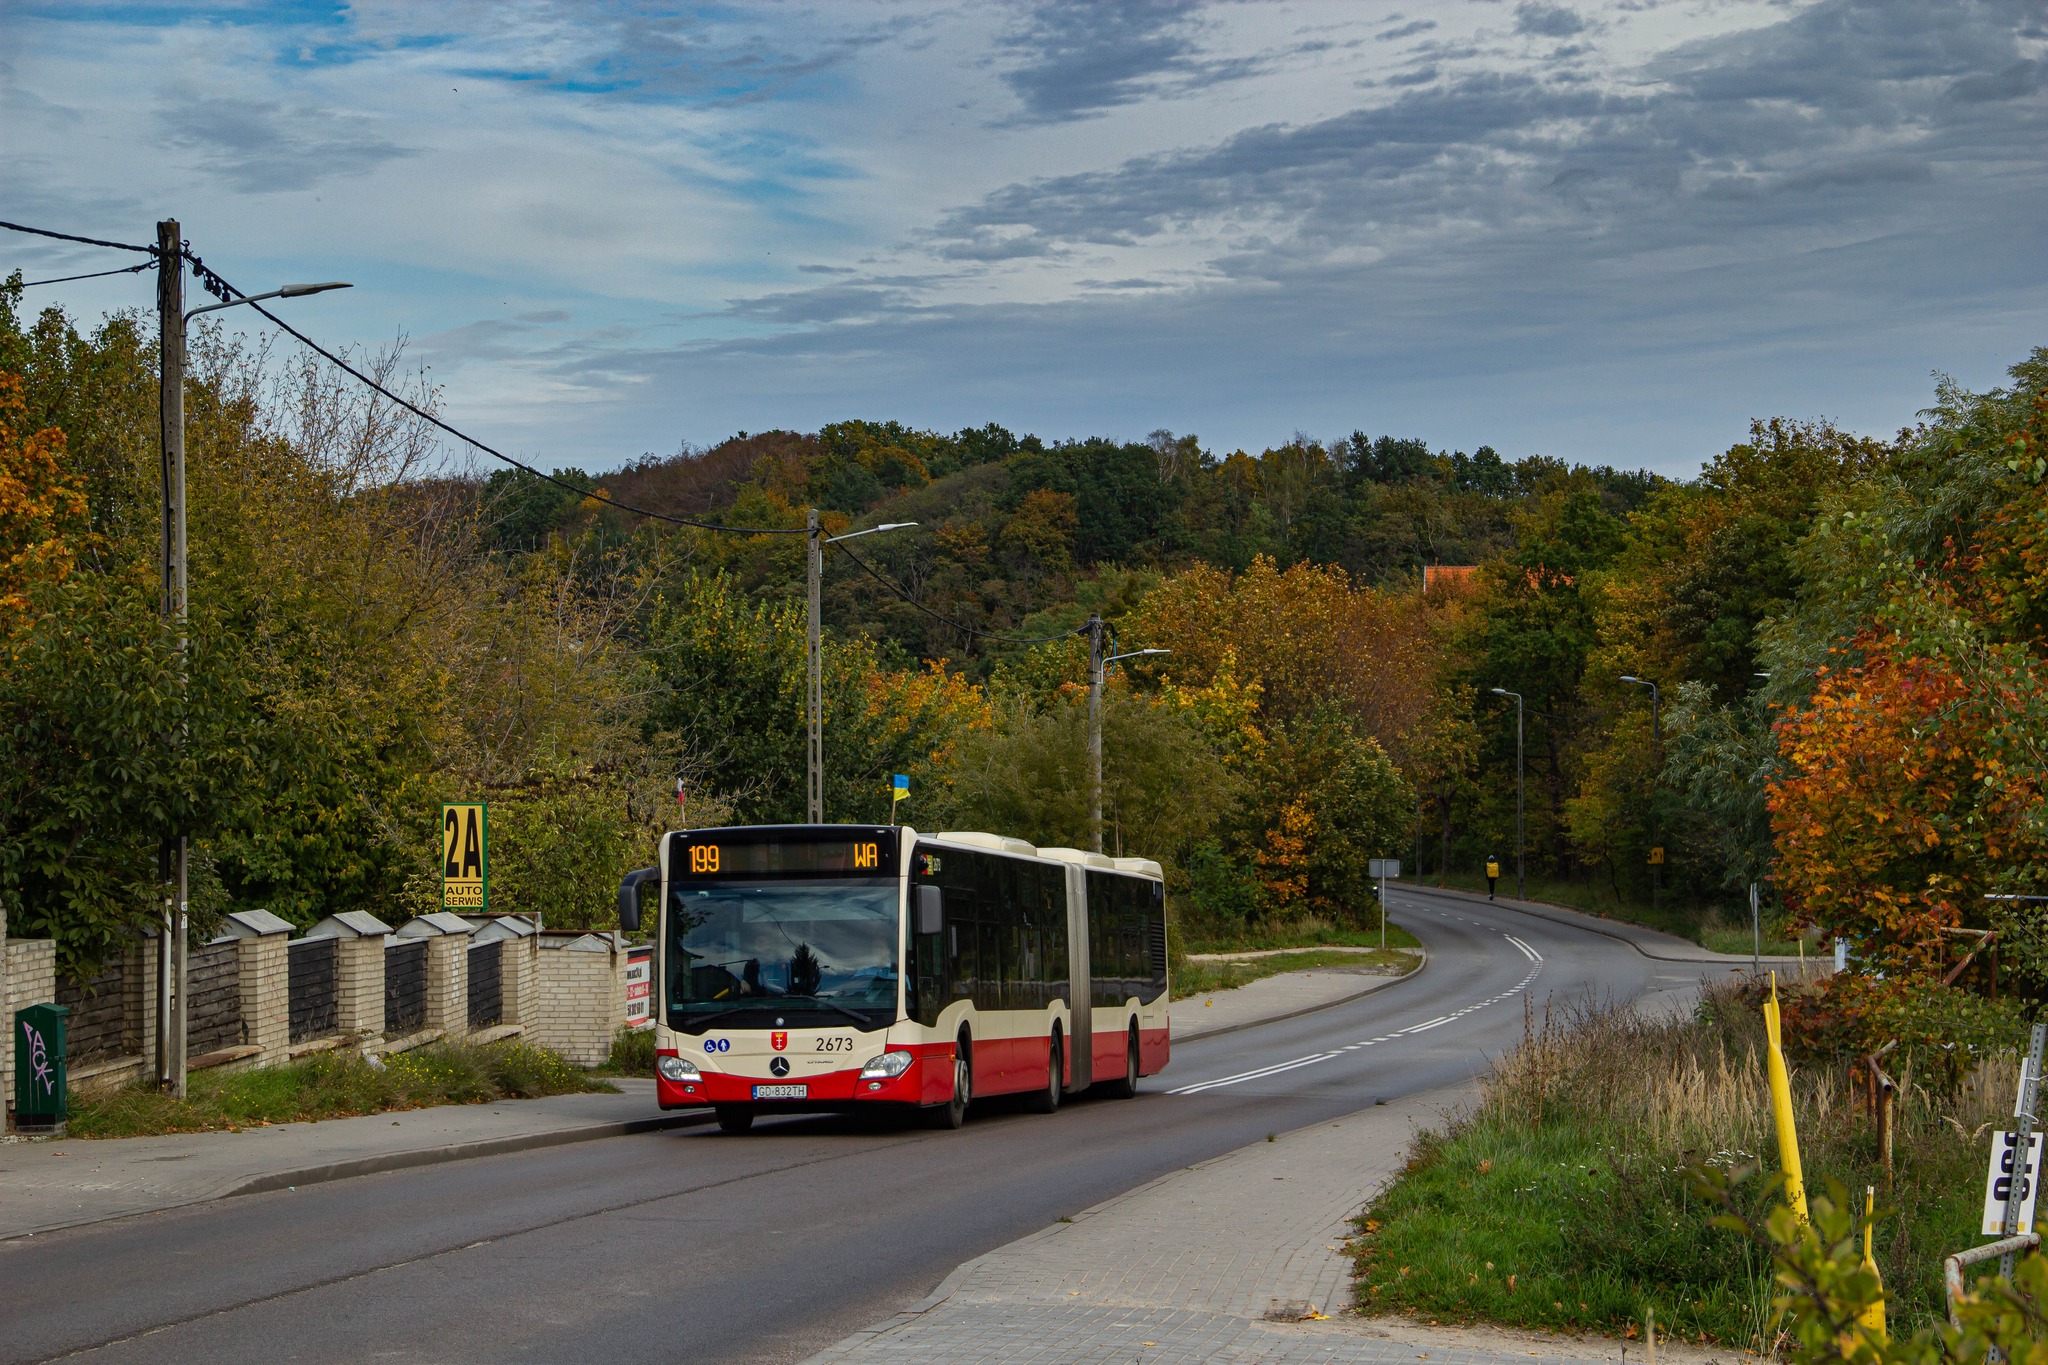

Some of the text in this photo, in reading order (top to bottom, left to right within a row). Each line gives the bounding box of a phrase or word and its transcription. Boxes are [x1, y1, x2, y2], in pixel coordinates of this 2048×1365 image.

[445, 808, 482, 878] 2A
[688, 843, 878, 873] 199 WA
[445, 886, 483, 896] AUTO
[445, 896, 483, 906] SERWIS
[815, 1037, 853, 1052] 2673
[758, 1086, 805, 1097] GD 832TH
